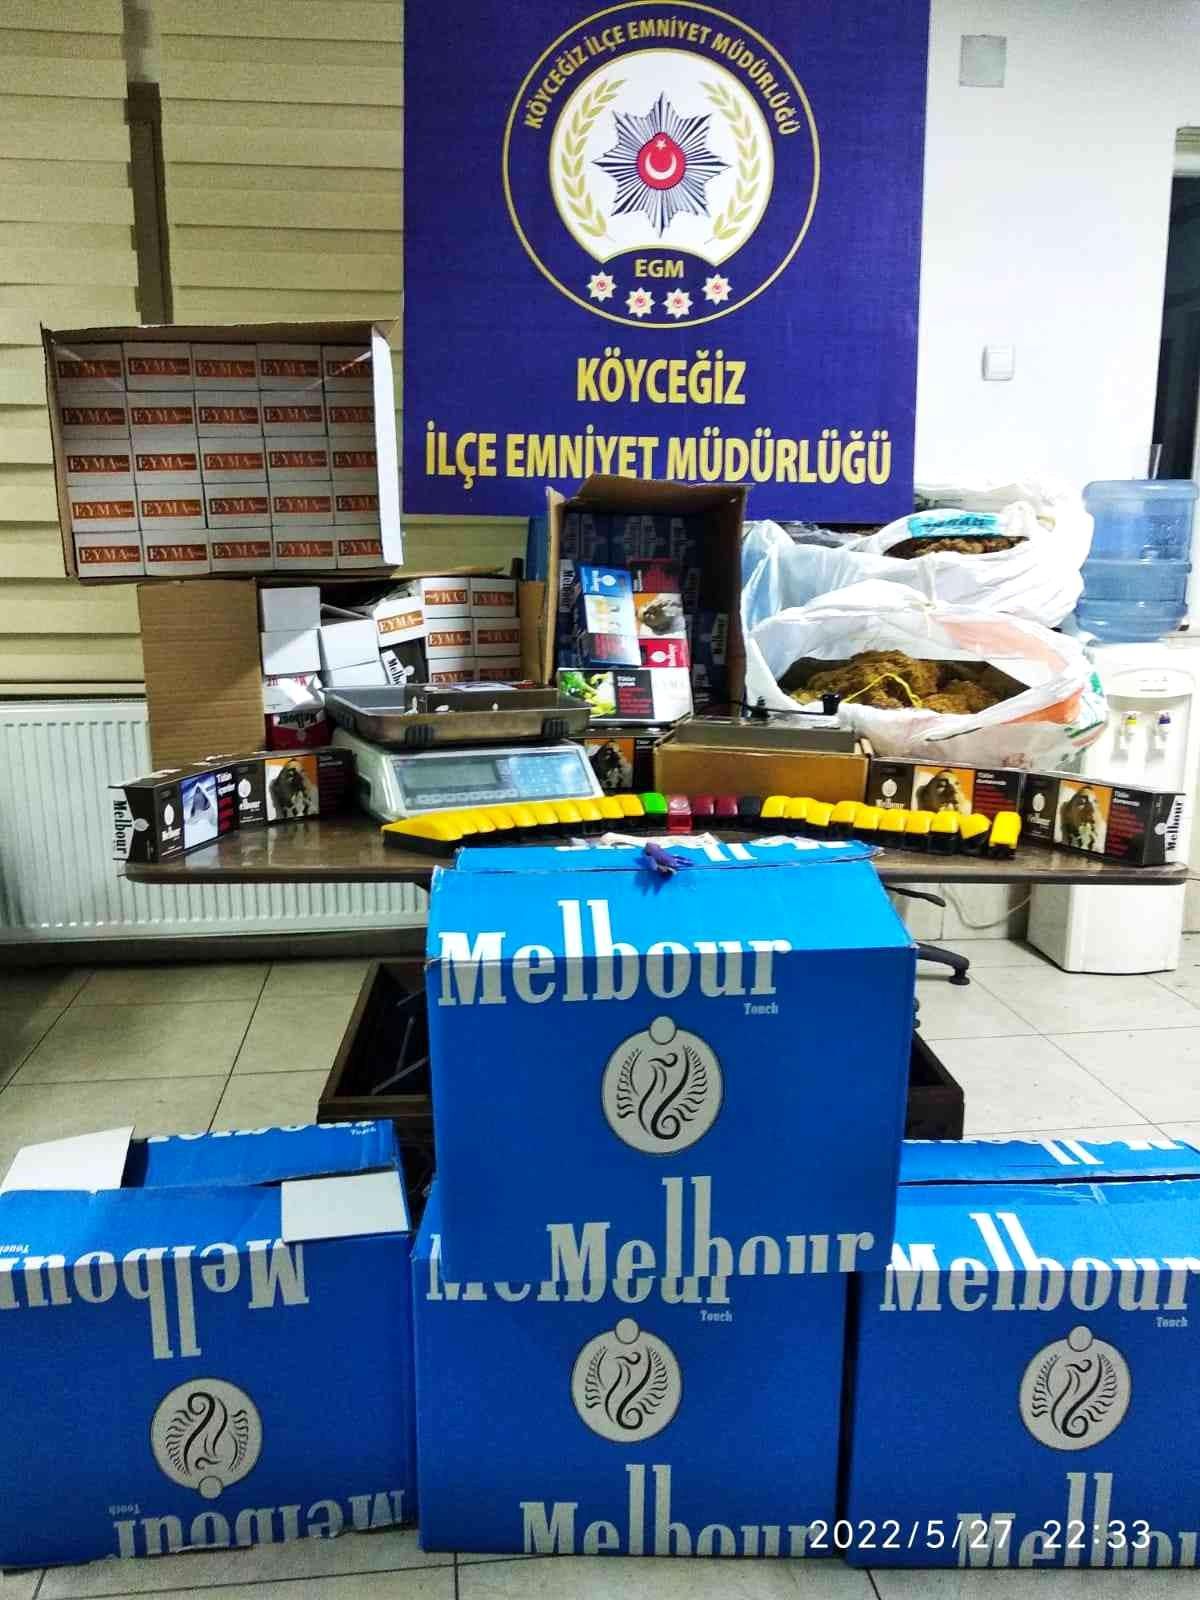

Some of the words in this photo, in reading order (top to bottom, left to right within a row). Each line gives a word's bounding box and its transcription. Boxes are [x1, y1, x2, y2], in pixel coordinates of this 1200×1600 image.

[524, 46, 589, 129] KÖYCEĞİZ
[584, 24, 626, 56] İLÇE
[627, 16, 712, 44] EMNİYET
[711, 33, 801, 136] MÜDÜRLÜĞÜ
[634, 259, 685, 278] EGM
[576, 347, 747, 405] KÖYCEĞİZ
[206, 455, 250, 468] EYMA
[271, 453, 315, 466] EYMA
[425, 420, 497, 490] İLÇE
[506, 424, 659, 481] EMNİYET
[667, 428, 892, 485] MÜDÜRLÜĞÜ
[70, 457, 118, 470] EYMA
[138, 456, 185, 469] EYMA
[75, 503, 122, 517] EYMA
[143, 502, 190, 516] EYMA
[211, 500, 257, 513] EYMA
[276, 499, 320, 512] EYMA
[81, 548, 129, 561] EYMA
[149, 547, 197, 560] EYMA
[214, 543, 259, 557] EYMA
[278, 542, 322, 555] EYMA
[113, 800, 133, 855] Melbour
[1165, 800, 1185, 851] Melbour
[438, 899, 793, 1007] Melbour
[744, 1002, 779, 1016] Touch
[546, 1175, 875, 1281] Melbour
[879, 1212, 1200, 1312] Melbour
[700, 1310, 733, 1323] Touch
[1156, 1315, 1189, 1329] Touch
